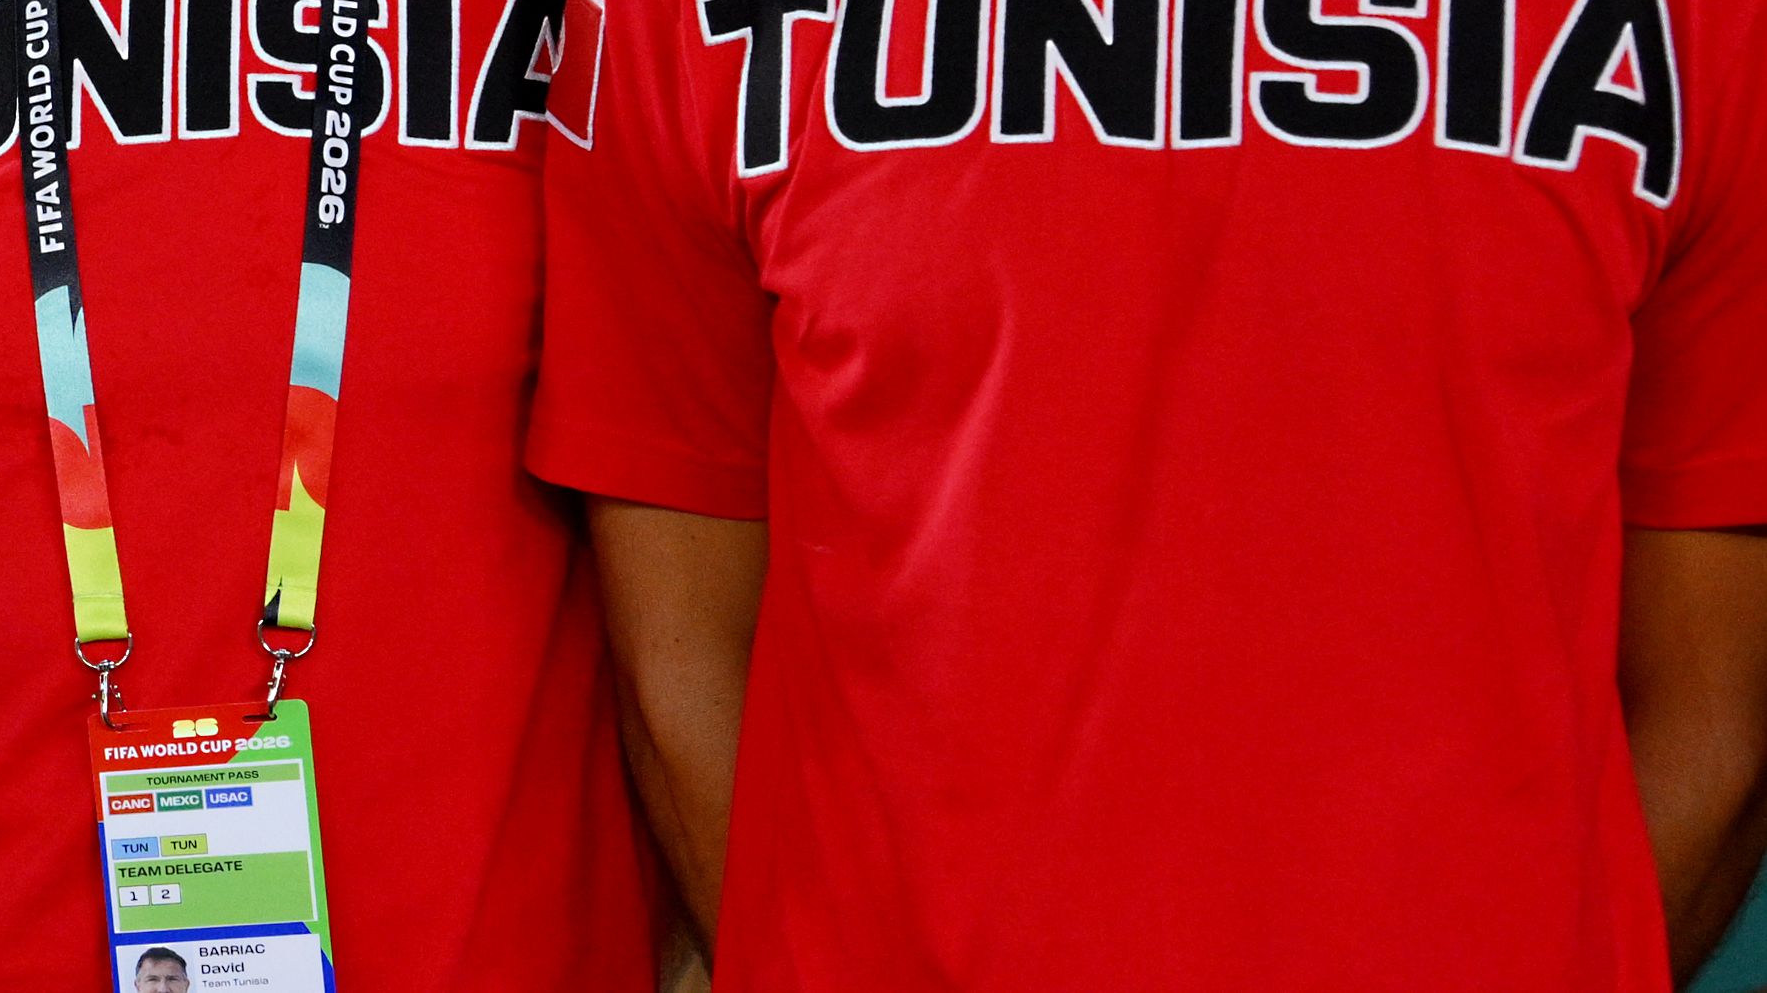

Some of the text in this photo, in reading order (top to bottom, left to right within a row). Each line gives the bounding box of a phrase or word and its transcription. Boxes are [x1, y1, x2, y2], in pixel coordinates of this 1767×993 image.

[25, 0, 50, 59] CUP
[328, 44, 357, 106] CUP
[28, 68, 57, 180] WORLD
[318, 110, 351, 224] 2026
[34, 180, 65, 254] FIFA
[104, 735, 292, 760] FIFA WORLD CUP 2026
[146, 770, 260, 786] TOURNAMENT PASS
[111, 791, 248, 810] CANC MEXC USAC
[122, 840, 198, 854] TUN TUN
[118, 860, 244, 878] TEAM DELEGATE
[160, 889, 171, 900] 2
[199, 943, 266, 957] BARRIAC
[201, 961, 245, 975] David
[202, 977, 269, 988] Team Tunisia
